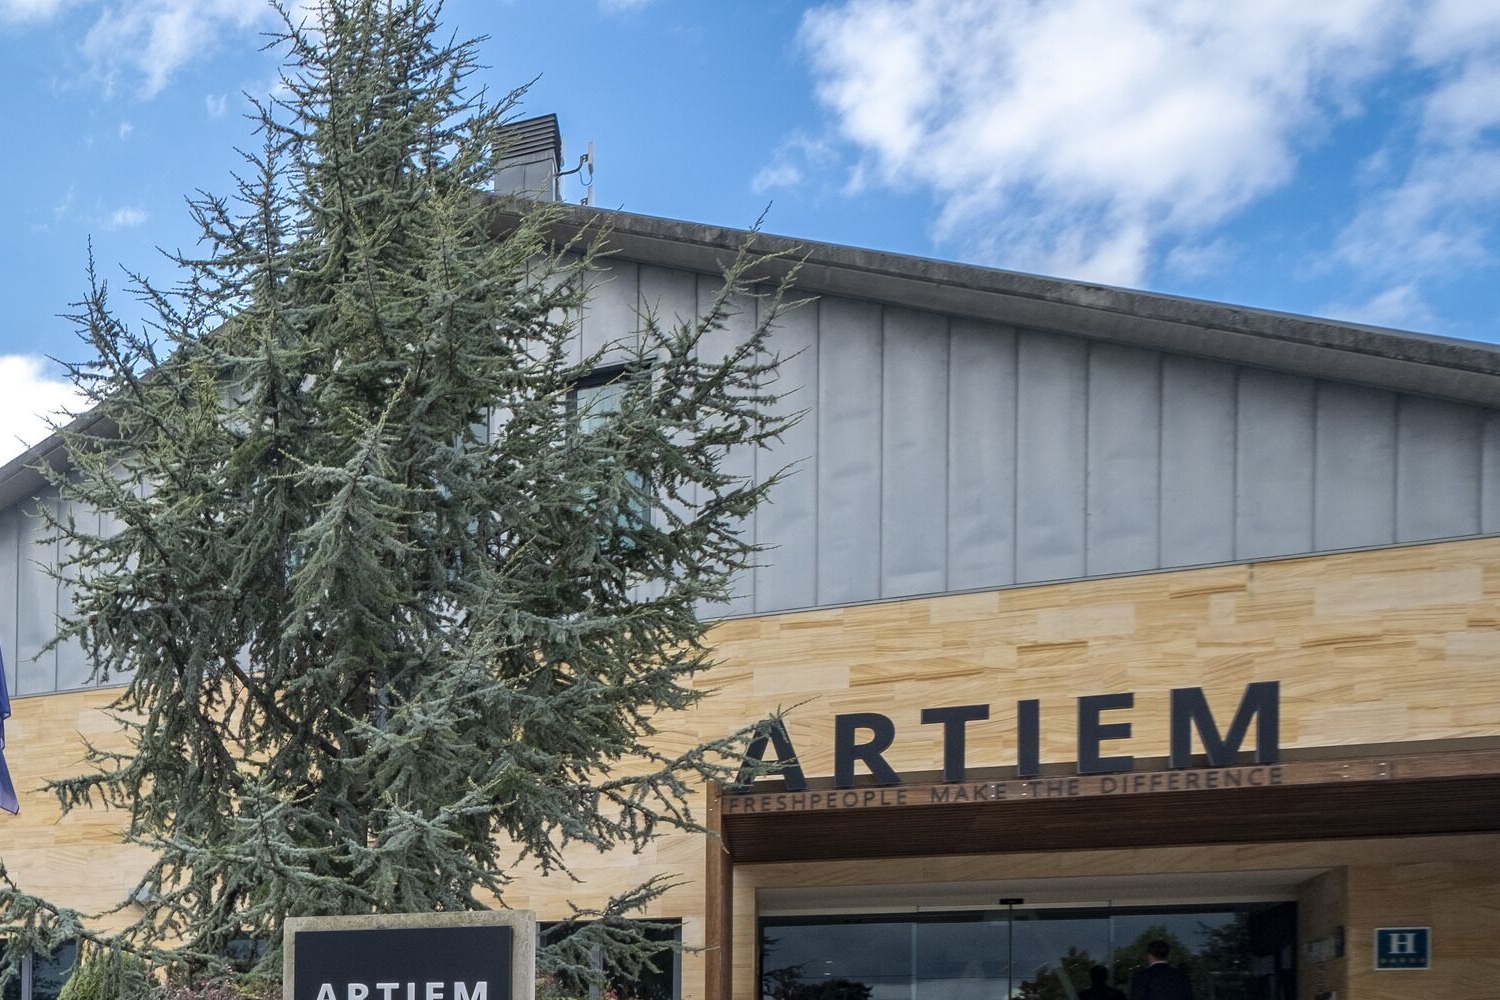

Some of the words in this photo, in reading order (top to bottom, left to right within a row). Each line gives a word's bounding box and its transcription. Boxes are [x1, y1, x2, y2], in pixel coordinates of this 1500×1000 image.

[729, 680, 1281, 795] ARTIEM
[728, 788, 908, 814] FRESHPEOPLE
[930, 783, 1007, 803] MAKE
[1028, 779, 1080, 798] THE
[1100, 766, 1283, 795] DIFFERENCE
[1387, 932, 1417, 954] H
